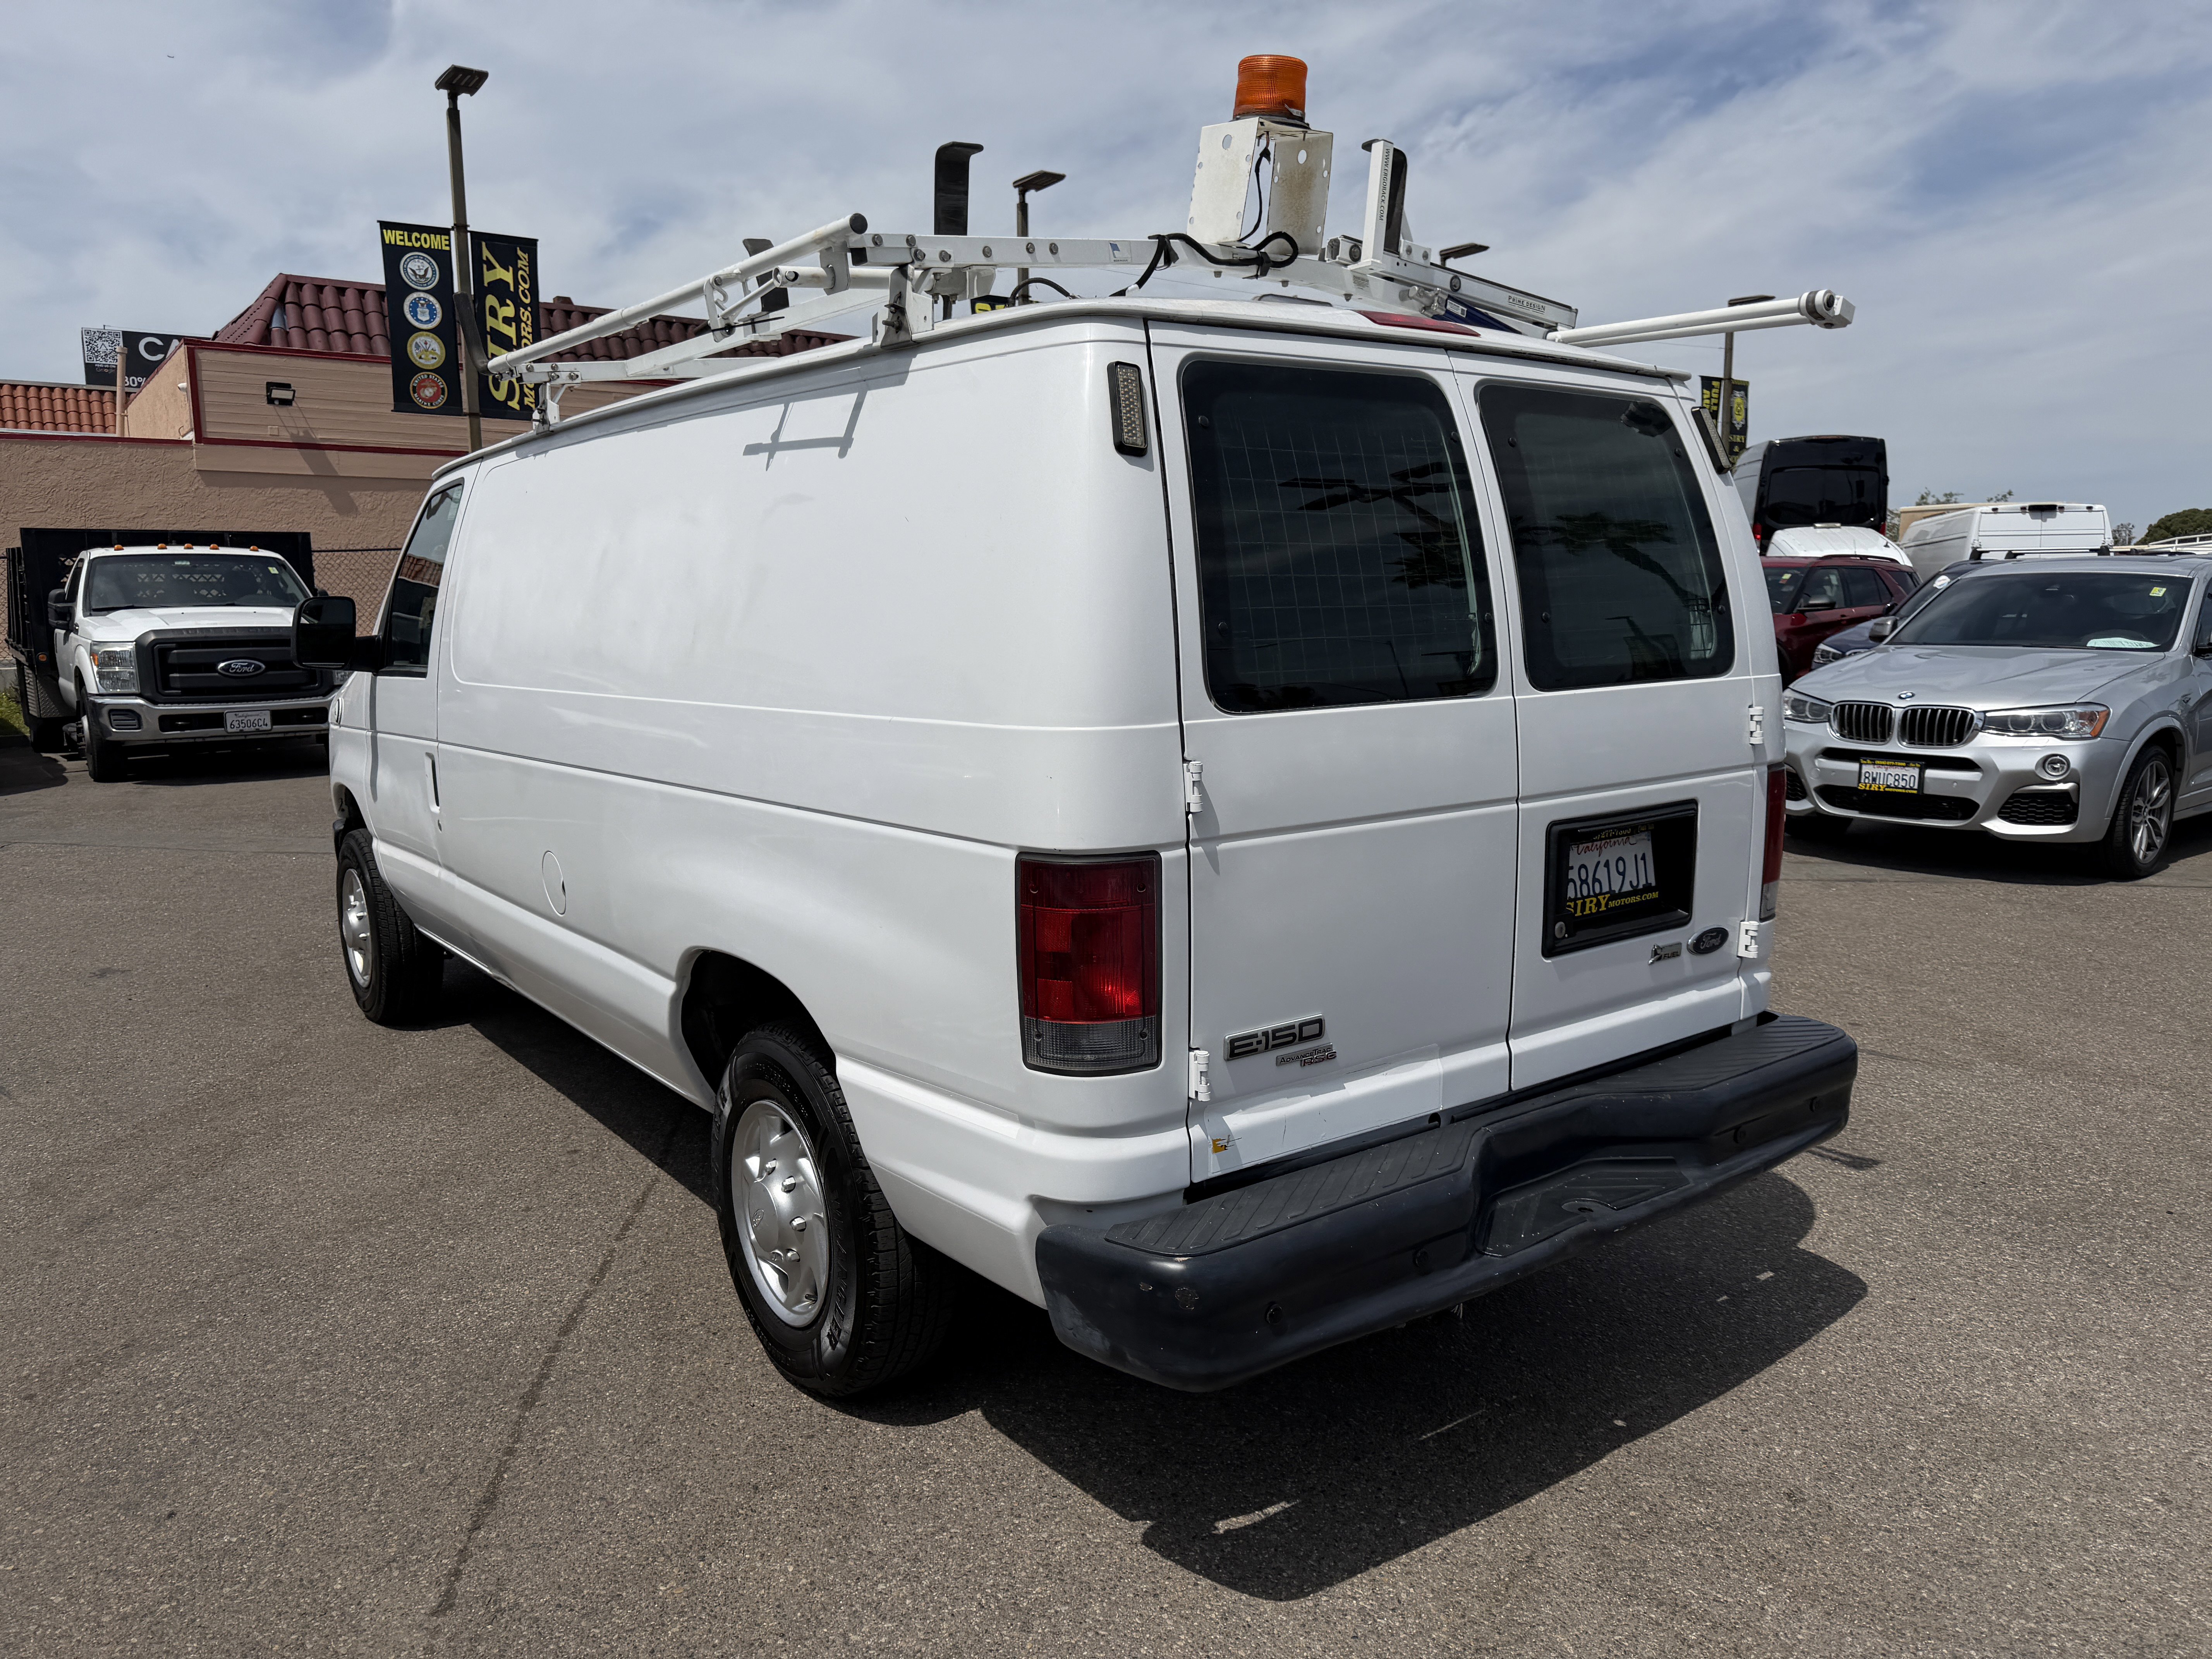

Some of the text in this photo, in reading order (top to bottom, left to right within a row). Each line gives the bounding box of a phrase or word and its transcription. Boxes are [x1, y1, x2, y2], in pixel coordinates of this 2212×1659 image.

[383, 229, 450, 251] WELCOME
[482, 241, 520, 410] SIRY
[229, 662, 254, 672] Ford
[1858, 783, 1887, 792] SIRY
[1864, 771, 1917, 788] 8WUC850
[1566, 891, 1659, 917] SIRY MOTORS.COM
[1700, 932, 1722, 949] Ford
[1229, 1018, 1323, 1058] E-150
[1302, 1050, 1336, 1066] RSC
